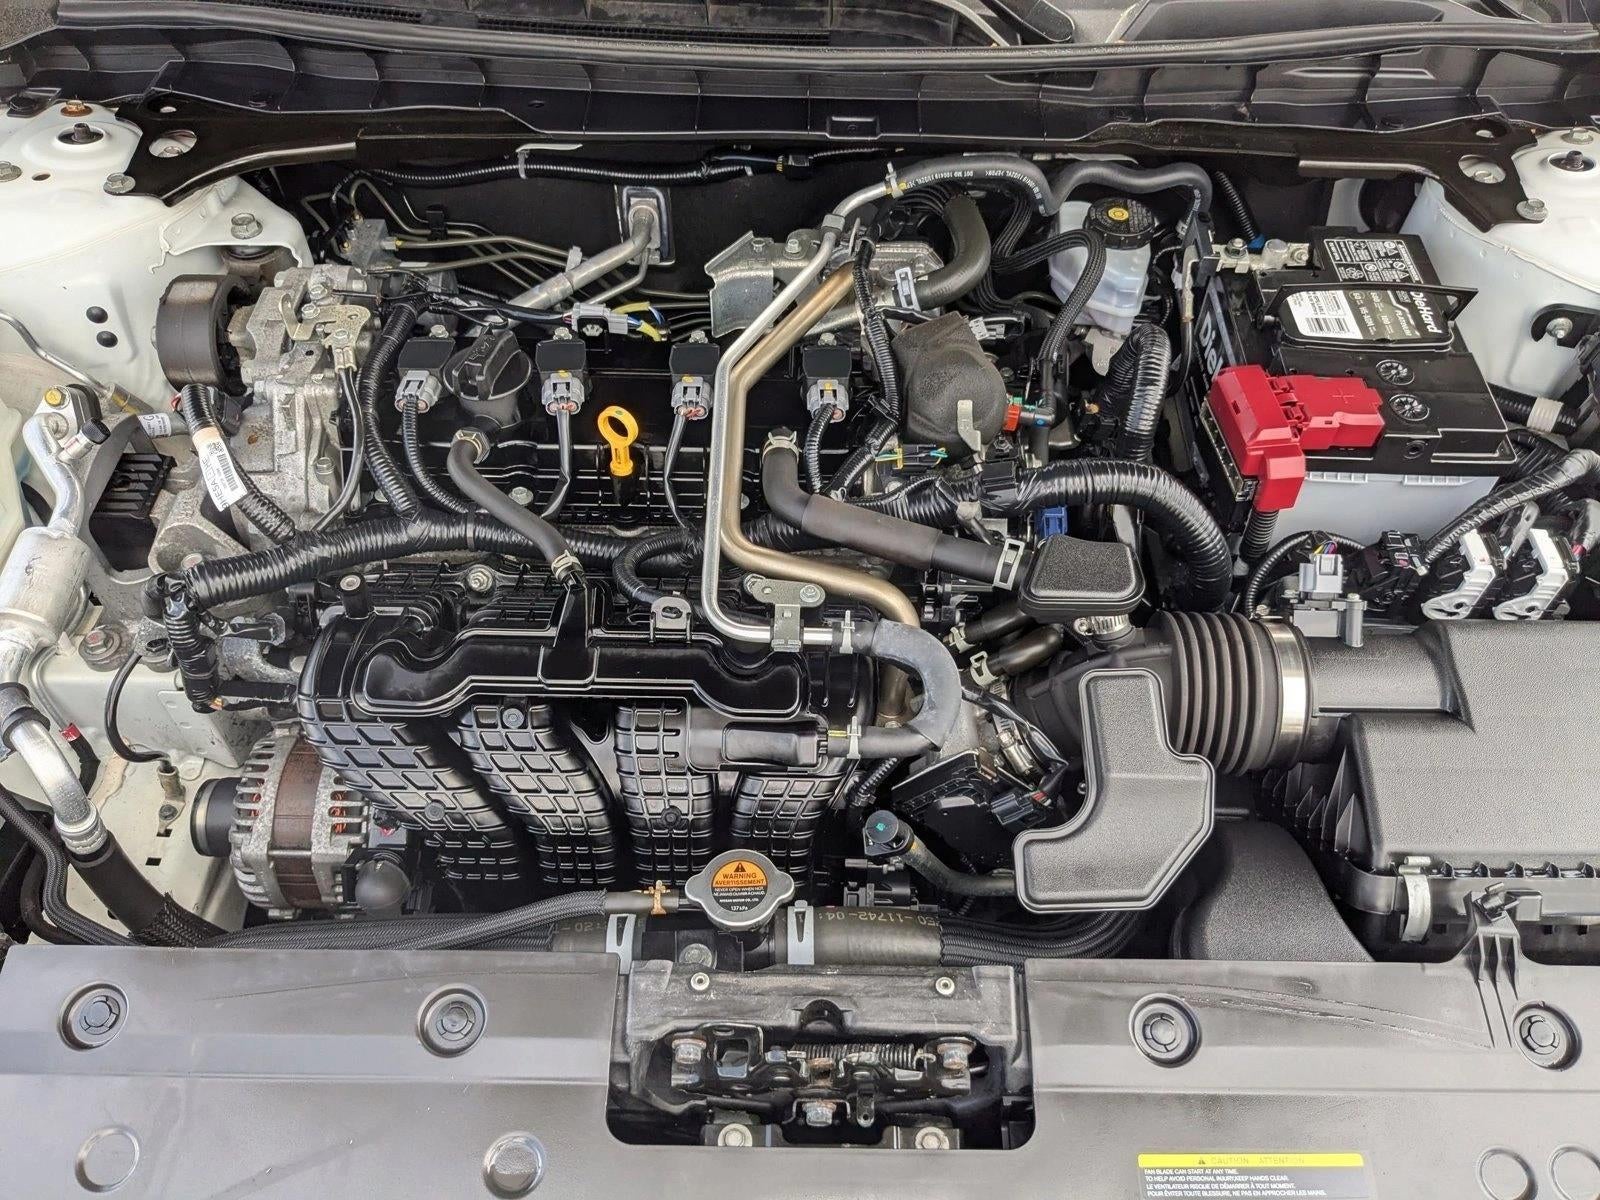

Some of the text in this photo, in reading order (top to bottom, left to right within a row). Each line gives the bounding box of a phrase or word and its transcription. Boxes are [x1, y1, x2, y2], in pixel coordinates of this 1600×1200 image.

[1410, 291, 1443, 333] DieHard
[1211, 1156, 1304, 1165] CAUTION ATTENTON
[1220, 1181, 1250, 1189] DÉMARRER
[1163, 1189, 1183, 1197] ÉVITER
